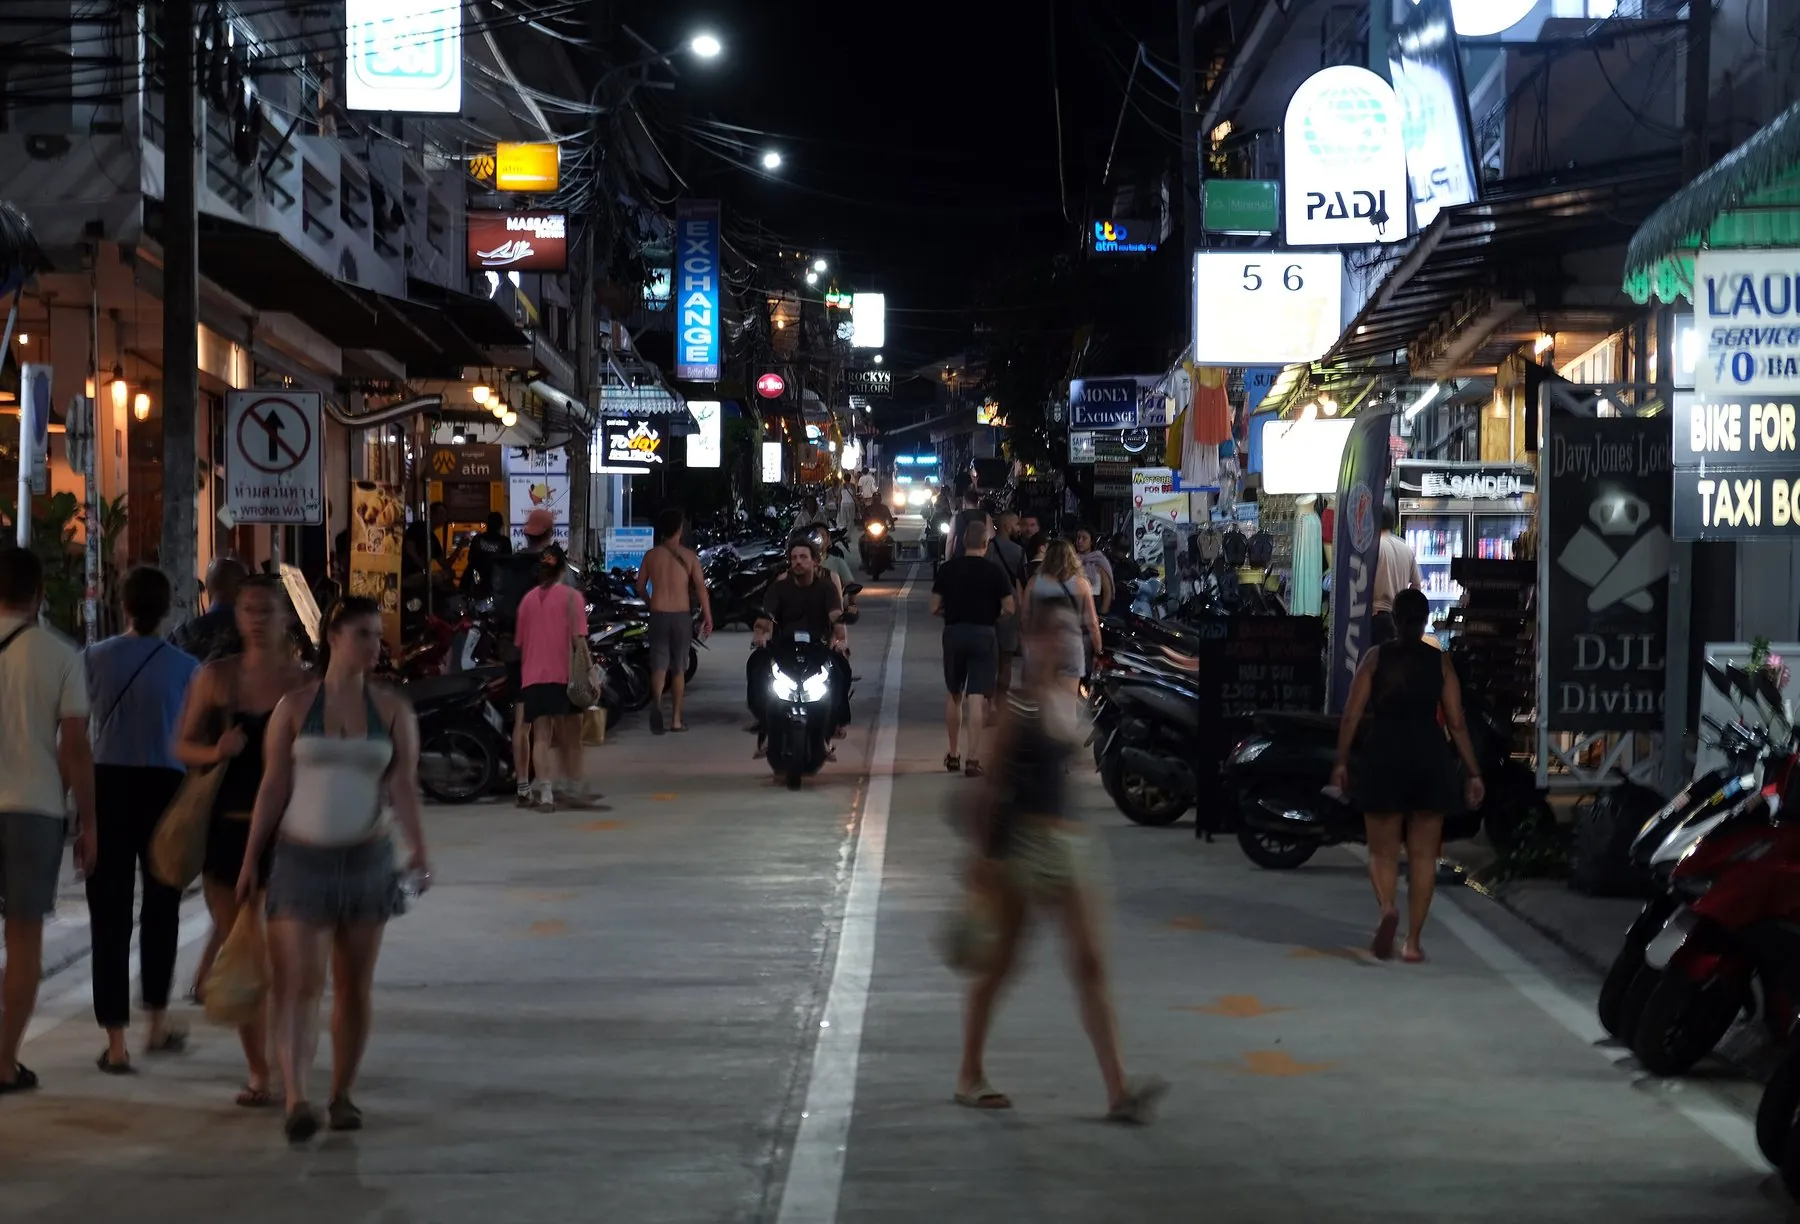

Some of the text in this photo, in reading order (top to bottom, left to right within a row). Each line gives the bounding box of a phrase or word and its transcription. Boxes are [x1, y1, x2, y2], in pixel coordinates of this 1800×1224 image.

[1306, 190, 1386, 221] PADI
[1095, 221, 1127, 240] ttb
[1095, 241, 1118, 251] atm
[1243, 264, 1304, 291] 5 6
[684, 220, 712, 363] EXCHANGE
[1708, 276, 1800, 316] LAU
[848, 371, 890, 382] ROCKYS
[1080, 389, 1129, 402] MONEY
[1690, 403, 1796, 452] BIKE FOR
[461, 463, 490, 475] atm
[1451, 474, 1521, 497] SANDEN
[241, 506, 280, 516] WRONG
[283, 506, 306, 516] WAY
[1697, 479, 1762, 527] TAXI
[1572, 633, 1665, 671] DJL
[1270, 665, 1295, 681] DAY
